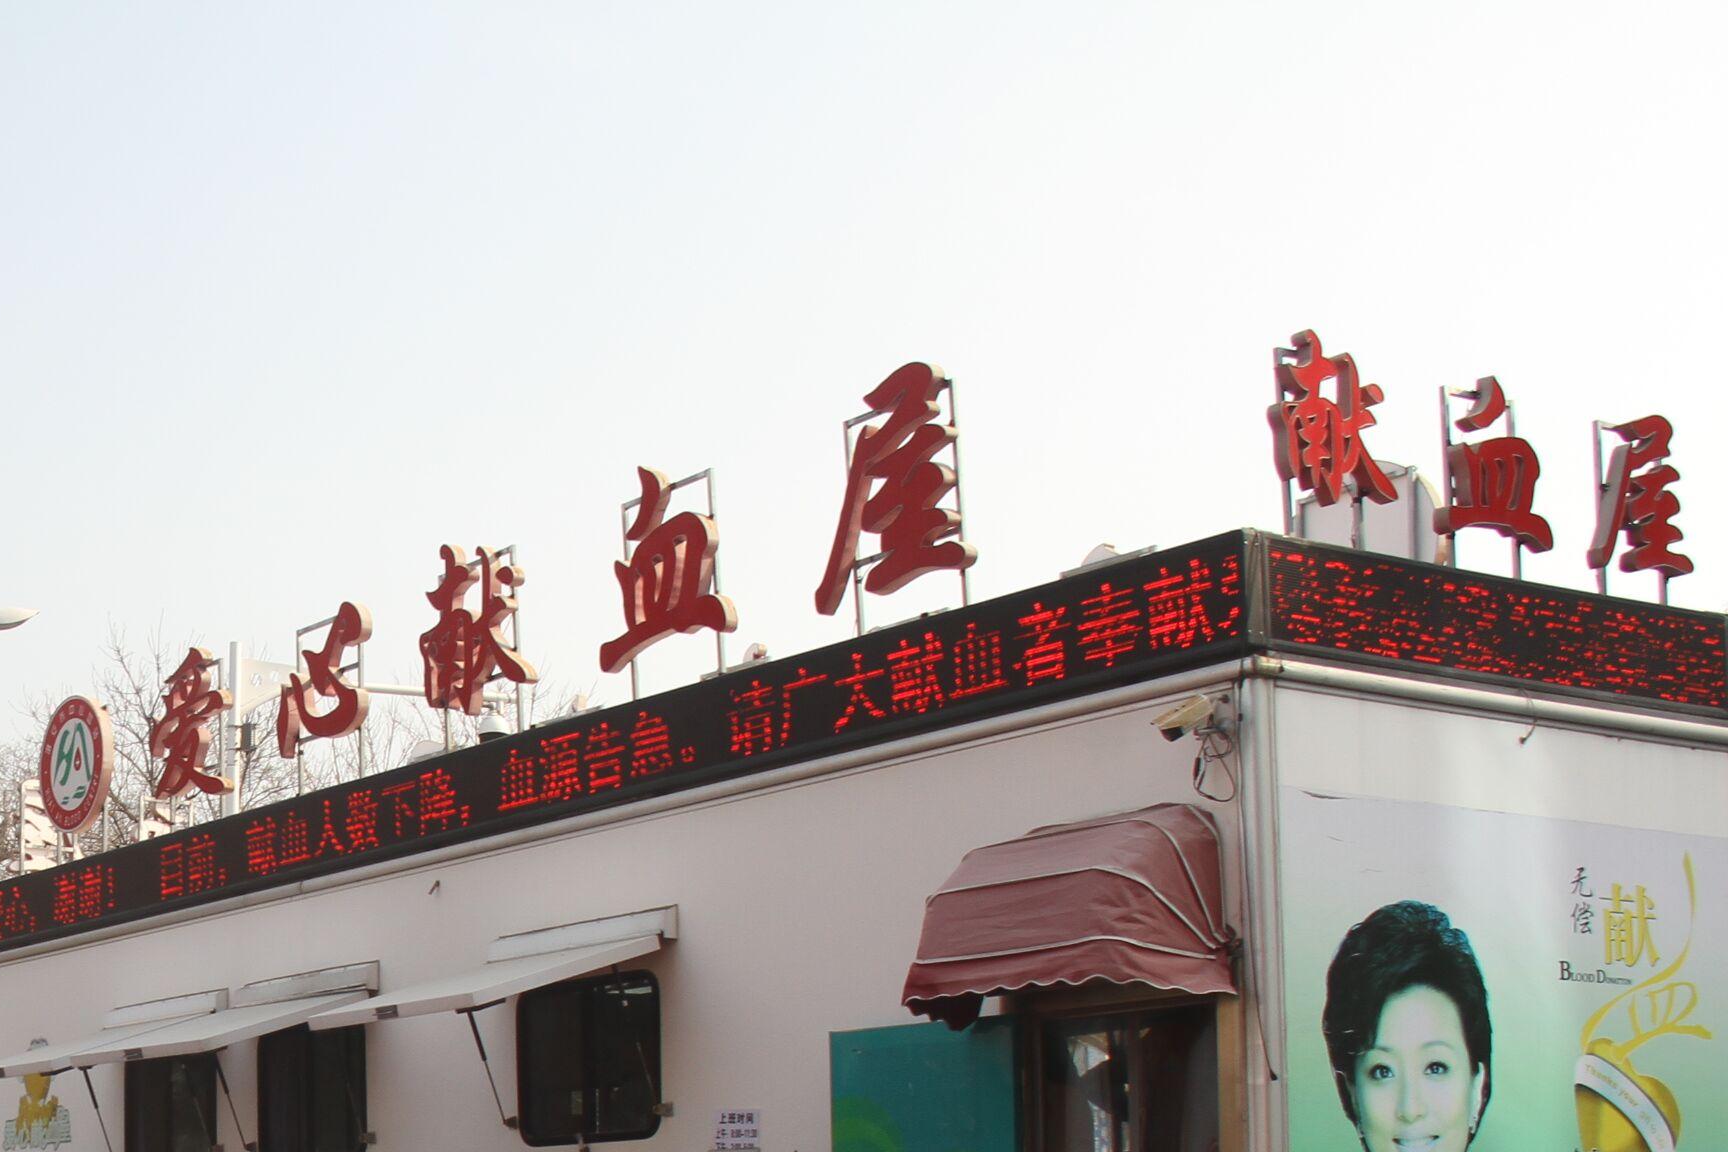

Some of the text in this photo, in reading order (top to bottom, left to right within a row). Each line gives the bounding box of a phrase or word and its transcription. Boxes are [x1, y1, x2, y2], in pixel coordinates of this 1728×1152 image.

[1268, 329, 1694, 578] 献血屋
[150, 361, 978, 798] 爱心献血屋
[1559, 961, 1594, 982] BLOOD
[1570, 867, 1594, 934] 无偿
